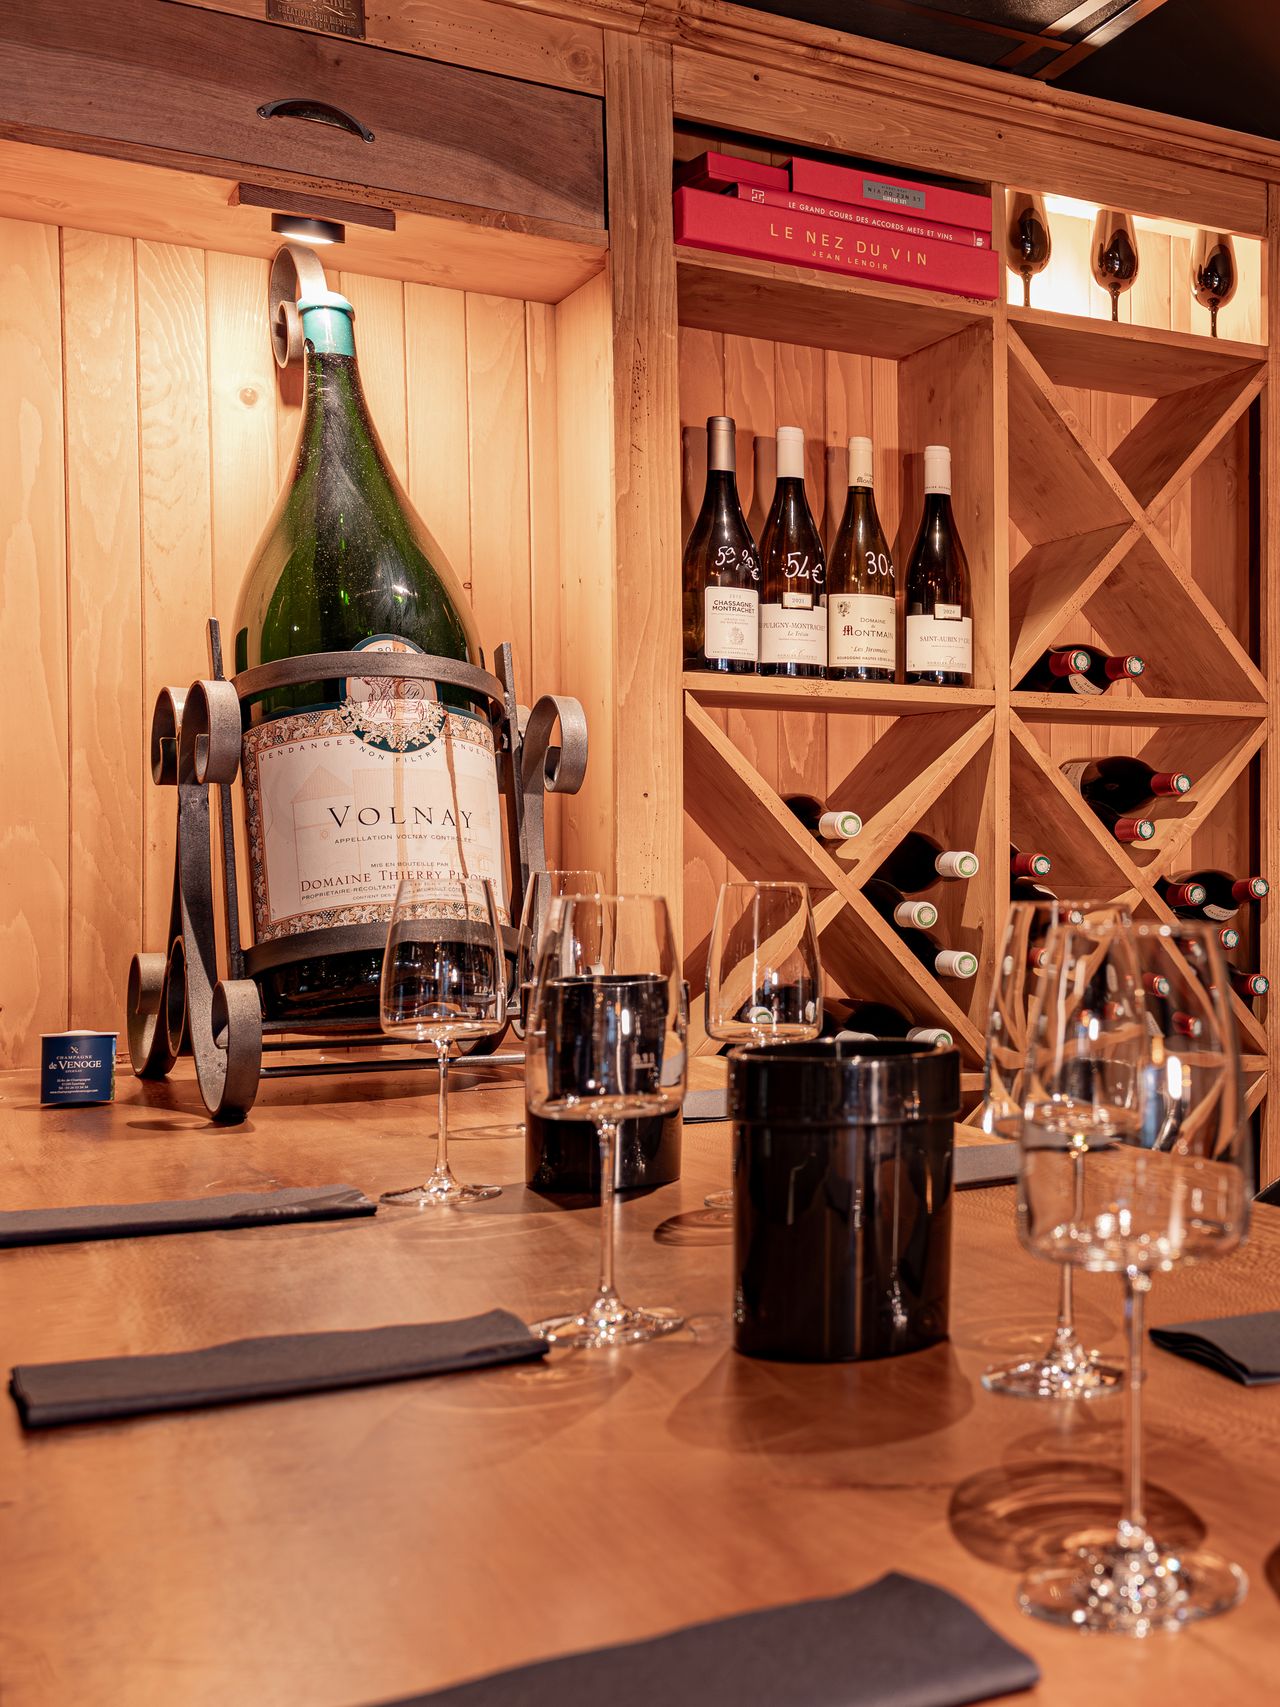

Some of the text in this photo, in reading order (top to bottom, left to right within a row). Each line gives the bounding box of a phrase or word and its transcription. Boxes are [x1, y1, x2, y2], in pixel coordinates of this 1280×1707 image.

[316, 13, 328, 22] SUR
[788, 201, 953, 241] LE GRAND COURS DES ACCORDS METS ET VINS
[770, 223, 927, 266] LE NEZ DU VIN
[812, 249, 888, 271] JEAN LENOIR
[711, 605, 755, 615] MONTRACHET
[842, 624, 894, 640] MONTMAIN
[260, 738, 356, 761] VENDANGES
[358, 746, 385, 761] NON
[327, 805, 473, 829] VOLNAY
[334, 834, 393, 844] APPELLATION
[301, 872, 372, 892] DOMAINE
[379, 870, 442, 881] THIERRY
[48, 1060, 102, 1070] de VENOGE
